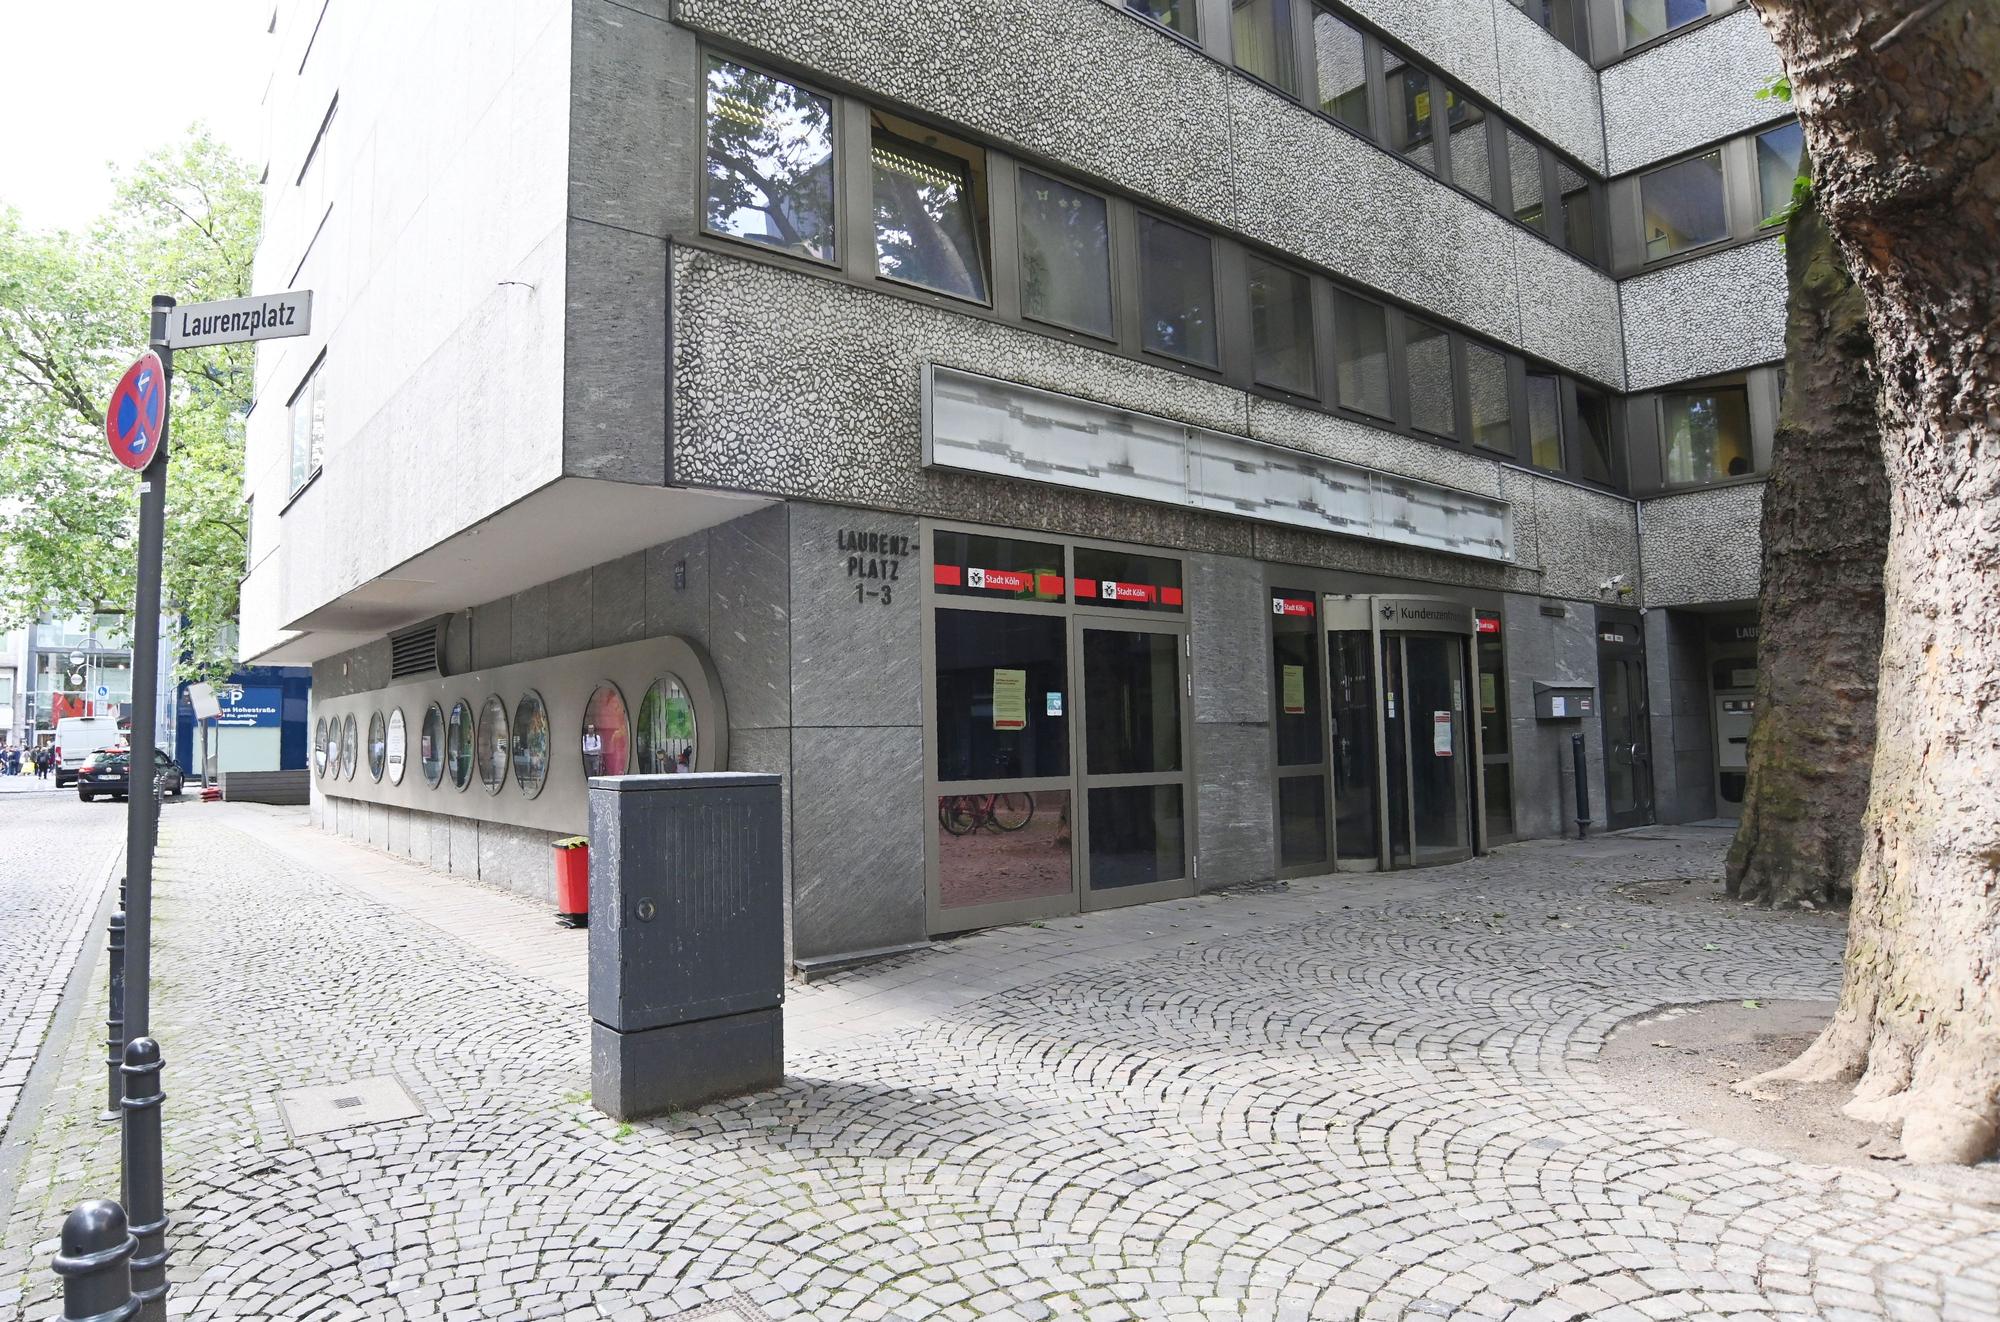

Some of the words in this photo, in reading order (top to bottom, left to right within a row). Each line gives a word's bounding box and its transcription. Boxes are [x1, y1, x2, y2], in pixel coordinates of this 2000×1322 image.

[182, 302, 295, 336] Laurenzplatz
[837, 529, 920, 556] LAURENZ-
[848, 556, 899, 581] PLATZ
[985, 574, 1004, 585] Stadt
[1004, 576, 1020, 586] Köln
[1117, 587, 1132, 596] Stadt
[1132, 588, 1146, 597] Köln
[1401, 607, 1462, 622] Kundenzent
